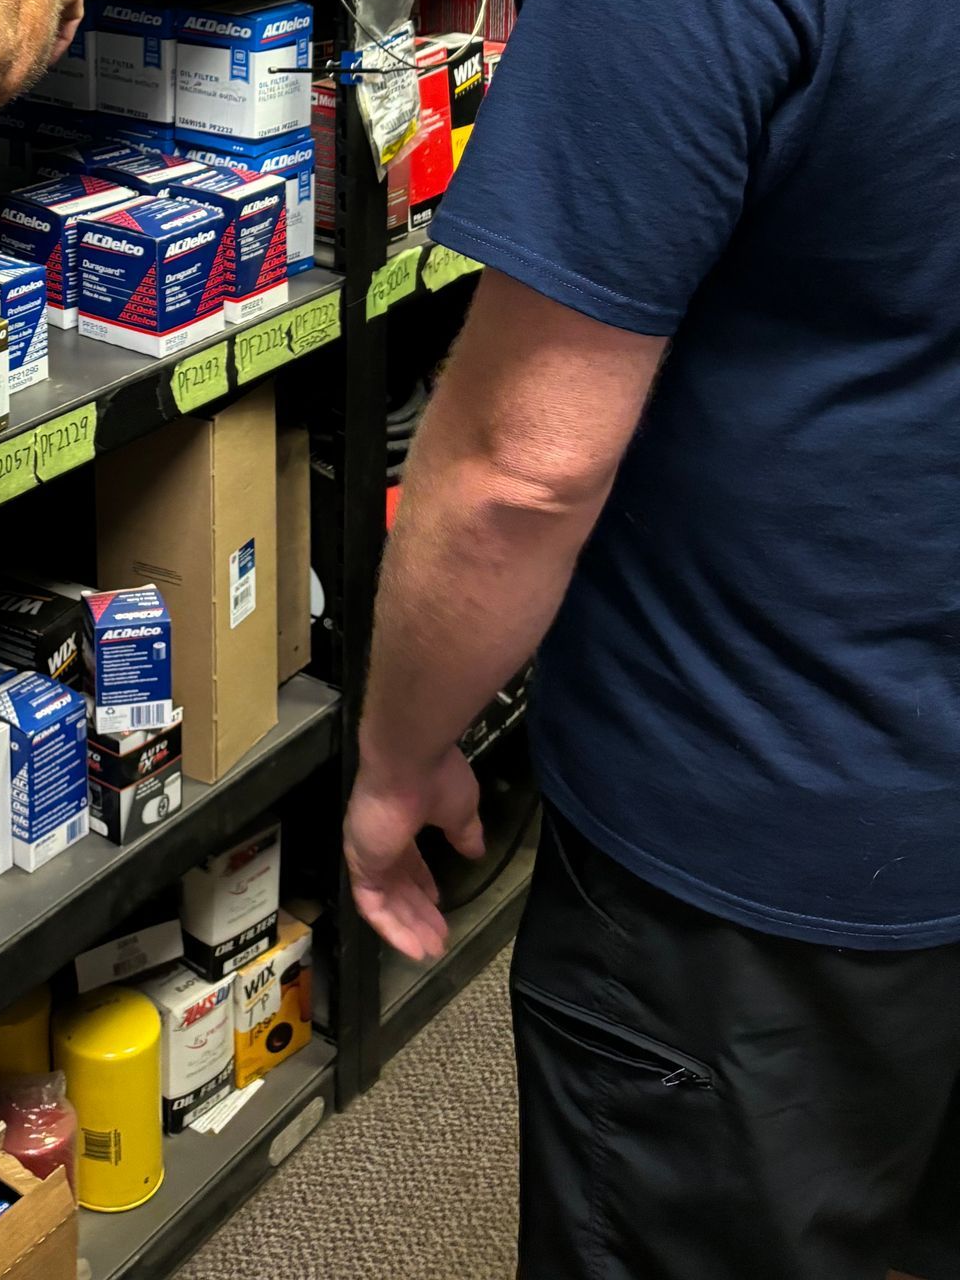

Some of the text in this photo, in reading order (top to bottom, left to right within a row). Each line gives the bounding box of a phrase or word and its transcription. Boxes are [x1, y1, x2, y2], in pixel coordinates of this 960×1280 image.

[103, 5, 162, 27] ACDelco
[185, 16, 251, 39] ACDelco
[263, 17, 310, 38] ACDelco
[454, 53, 482, 86] WIX
[261, 149, 312, 173] ACDelco
[241, 195, 279, 217] ACDelco
[1, 207, 51, 233] ACDelco
[82, 232, 144, 256] ACDelco
[165, 230, 216, 258] ACDelco
[7, 280, 44, 299] ACDelco
[7, 298, 42, 316] Professional
[240, 324, 284, 371] PF2221
[178, 357, 219, 402] PF2193
[39, 416, 89, 465] PF2129
[102, 627, 163, 641] ACDelco
[48, 633, 78, 675] WIX
[140, 740, 168, 760] AUTO
[214, 914, 278, 957] OIL FILTER
[244, 960, 275, 999] WIX
